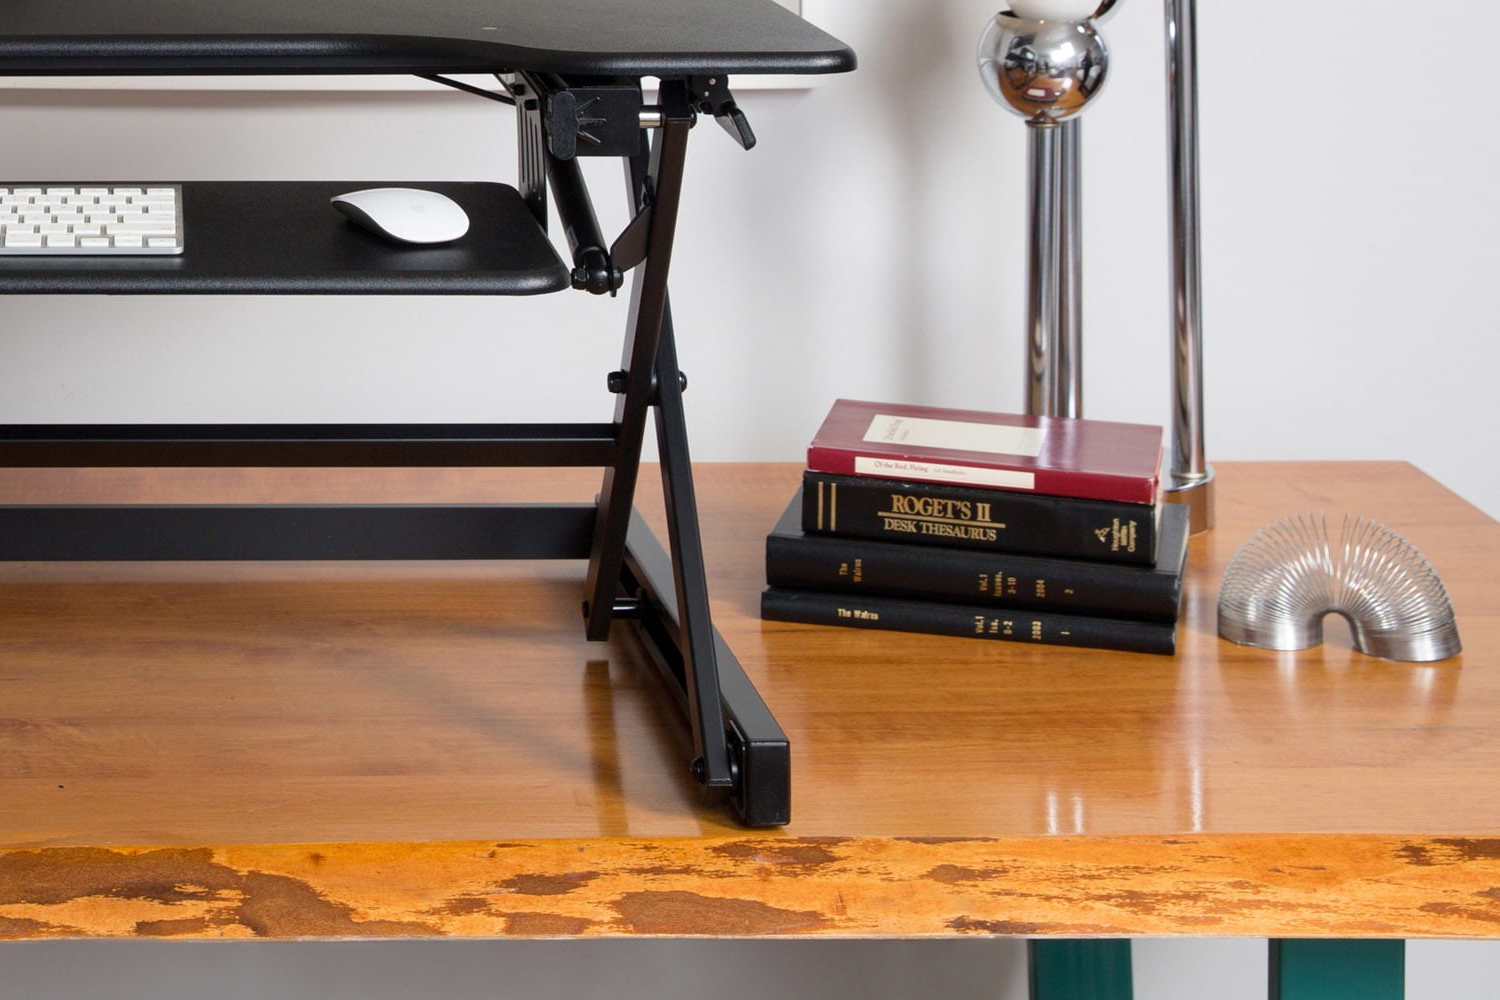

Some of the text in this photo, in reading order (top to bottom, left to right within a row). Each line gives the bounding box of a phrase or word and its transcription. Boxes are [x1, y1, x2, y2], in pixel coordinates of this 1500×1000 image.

[891, 494, 991, 522] ROGET'S II
[884, 517, 997, 542] DESK THESAURUS
[839, 562, 848, 576] The
[853, 558, 862, 583] Walrus
[1036, 579, 1046, 598] 2004
[837, 608, 879, 621] The Walrus
[1032, 620, 1042, 640] 2003
